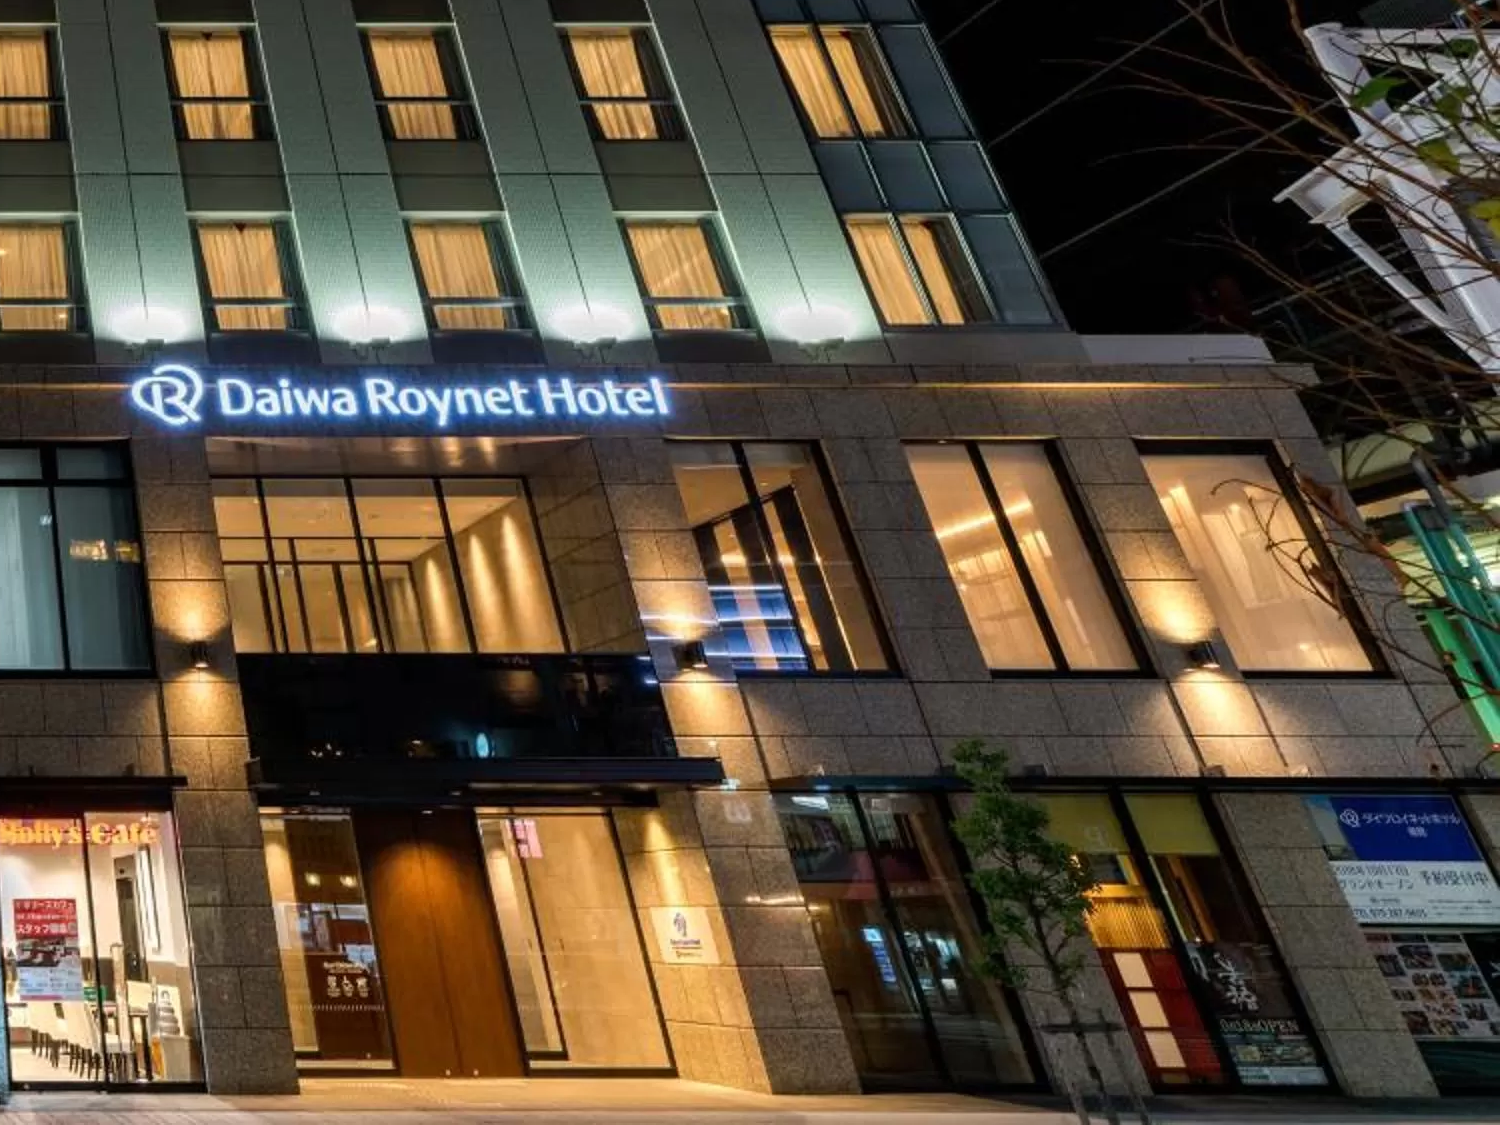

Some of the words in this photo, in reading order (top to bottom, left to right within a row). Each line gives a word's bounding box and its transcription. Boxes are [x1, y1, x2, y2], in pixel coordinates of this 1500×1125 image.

[218, 378, 356, 418] Daiwa
[366, 378, 535, 426] Roynet
[541, 378, 669, 418] Hotel
